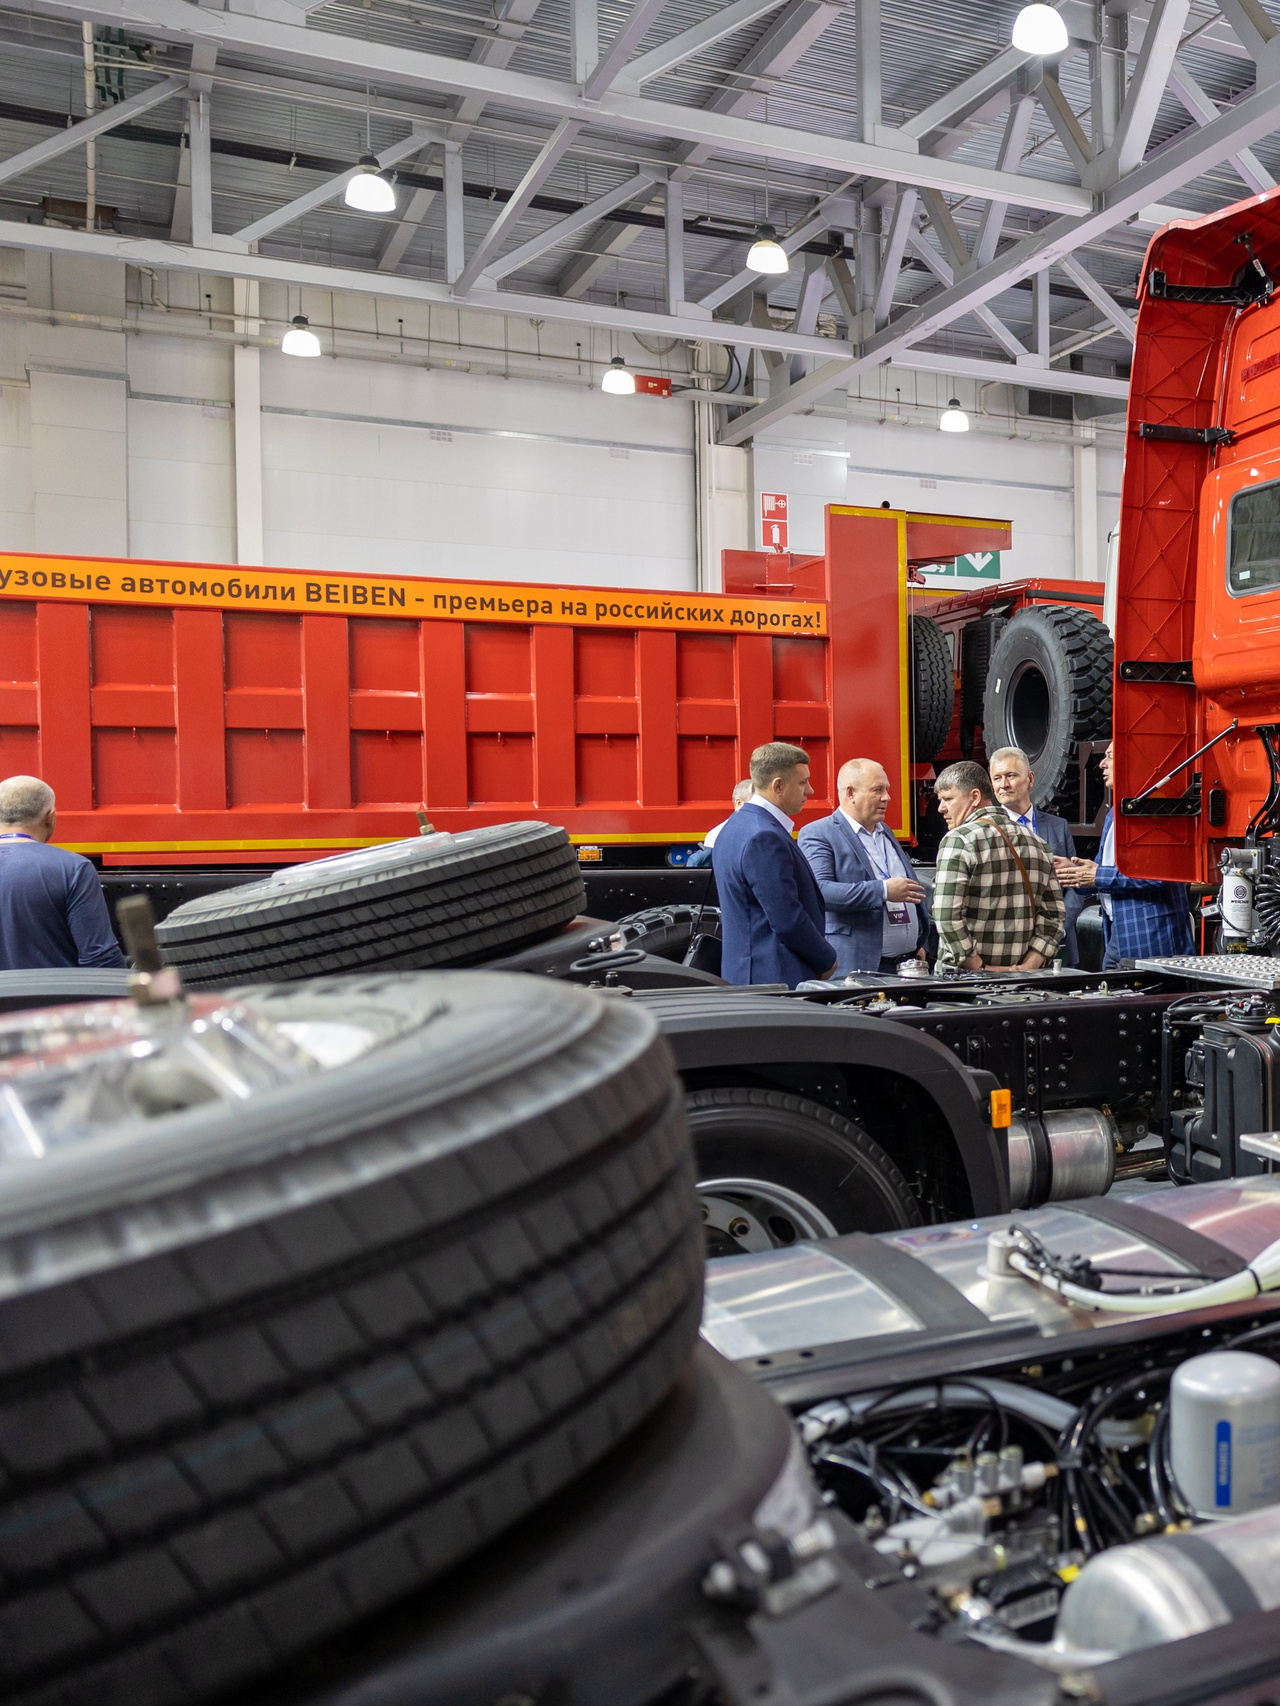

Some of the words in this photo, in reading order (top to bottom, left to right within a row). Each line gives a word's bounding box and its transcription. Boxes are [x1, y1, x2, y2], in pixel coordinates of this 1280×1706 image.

[120, 575, 295, 601] автомобили
[305, 582, 406, 607] BEIBEN
[433, 593, 553, 618] премьера
[561, 600, 587, 616] на
[595, 601, 724, 622] российских
[730, 608, 821, 630] дорогах!
